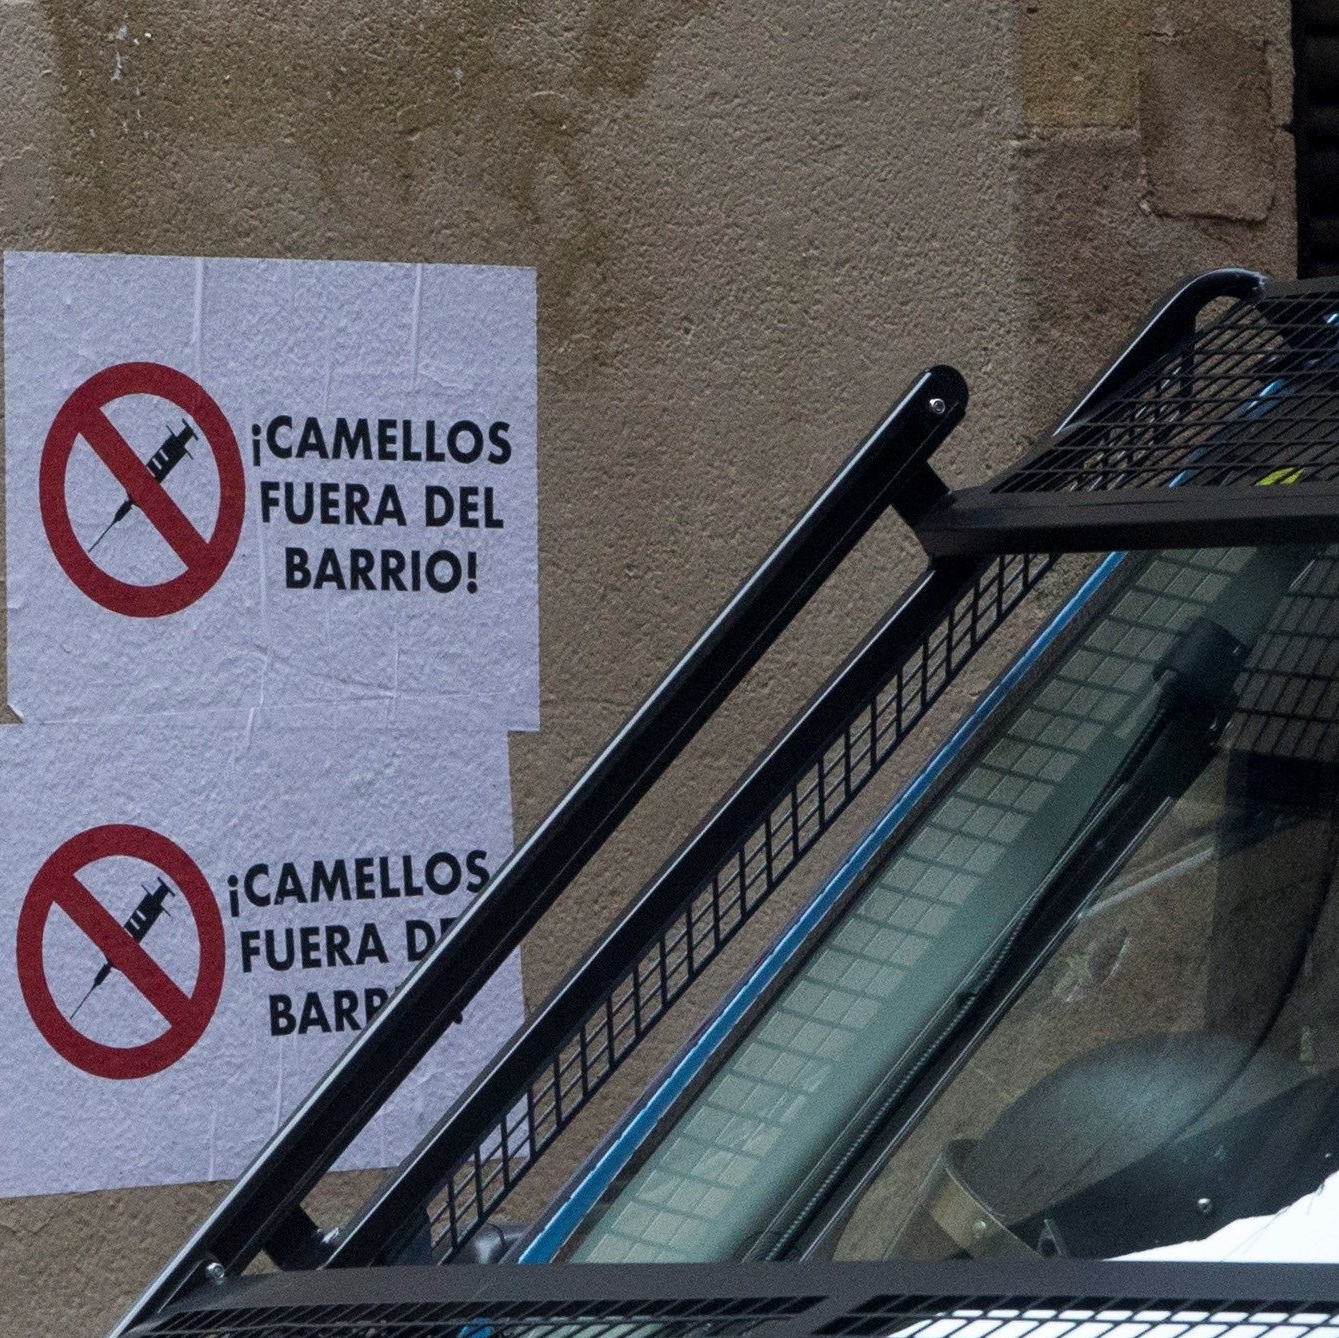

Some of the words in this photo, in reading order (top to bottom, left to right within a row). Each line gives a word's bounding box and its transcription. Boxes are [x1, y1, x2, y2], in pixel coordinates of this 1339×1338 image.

[251, 415, 512, 466] ¡CAMELLOS
[261, 481, 407, 527] FUERA
[425, 487, 504, 528] DEL
[285, 547, 477, 594] BARRIO!
[228, 849, 490, 917] ¡CAMELLOS
[241, 922, 389, 973] FUERA
